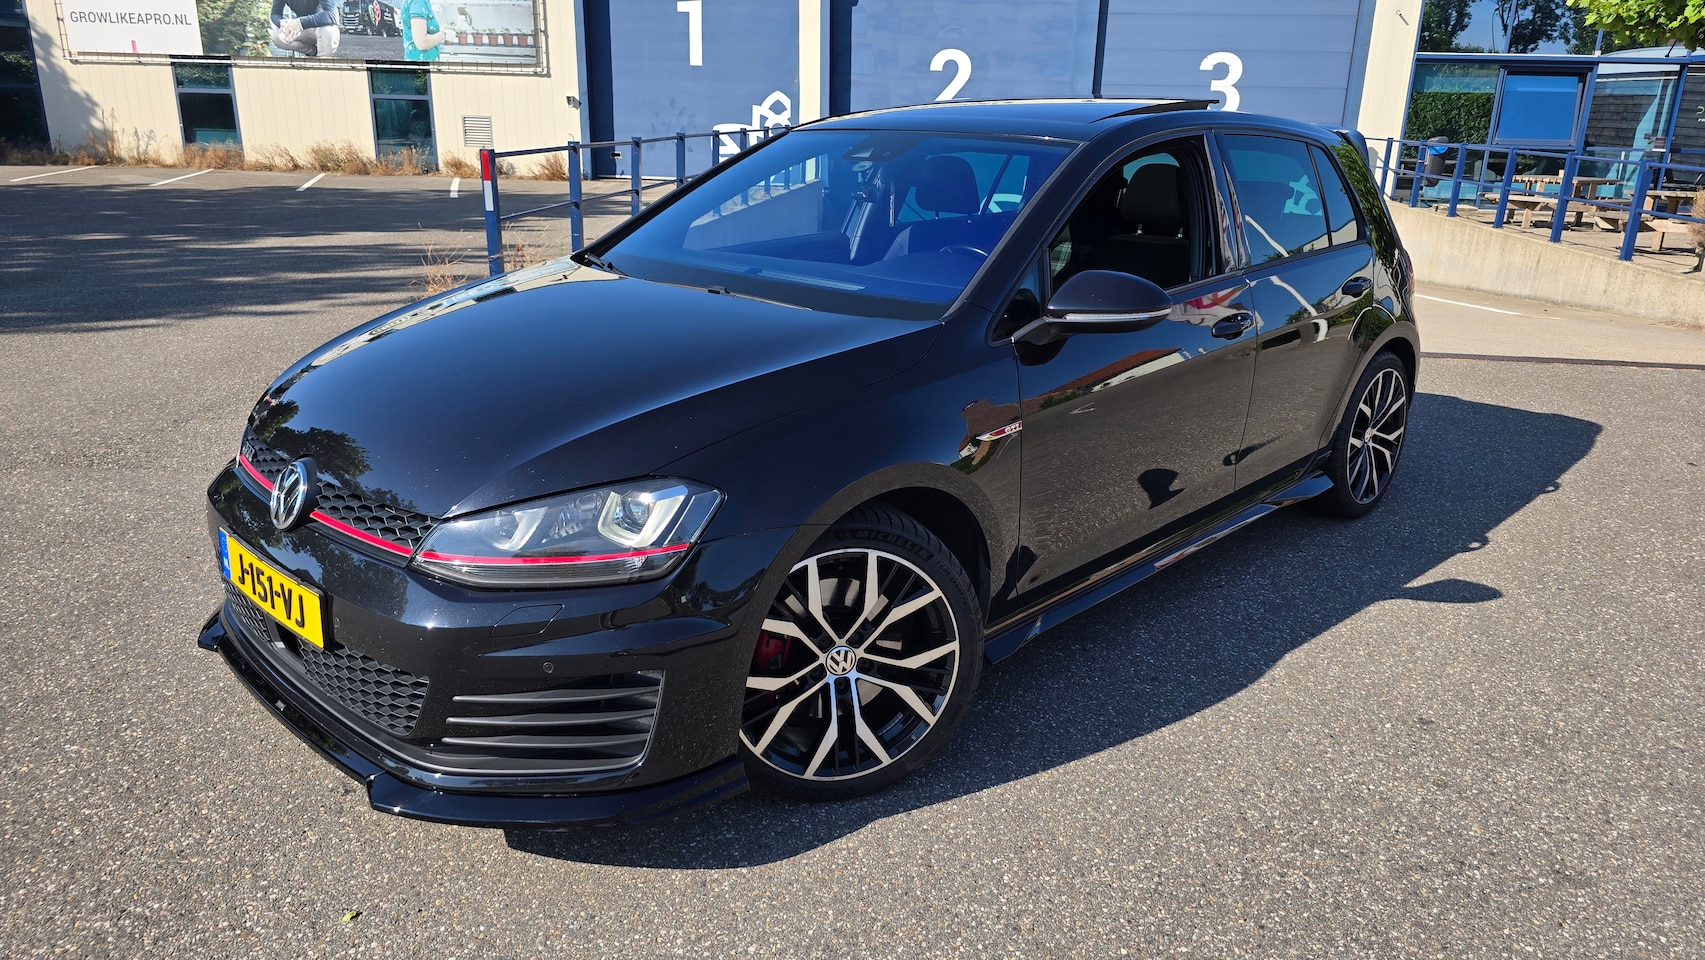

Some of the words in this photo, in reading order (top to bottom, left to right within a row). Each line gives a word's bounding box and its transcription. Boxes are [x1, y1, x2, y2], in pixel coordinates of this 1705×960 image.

[70, 11, 192, 26] GROWLIKEAPRO.NL
[677, 0, 703, 67] 1
[930, 48, 972, 102] 2
[1199, 51, 1243, 112] 3
[856, 530, 931, 560] MICHELIN
[238, 553, 305, 629] J-151-VJ
